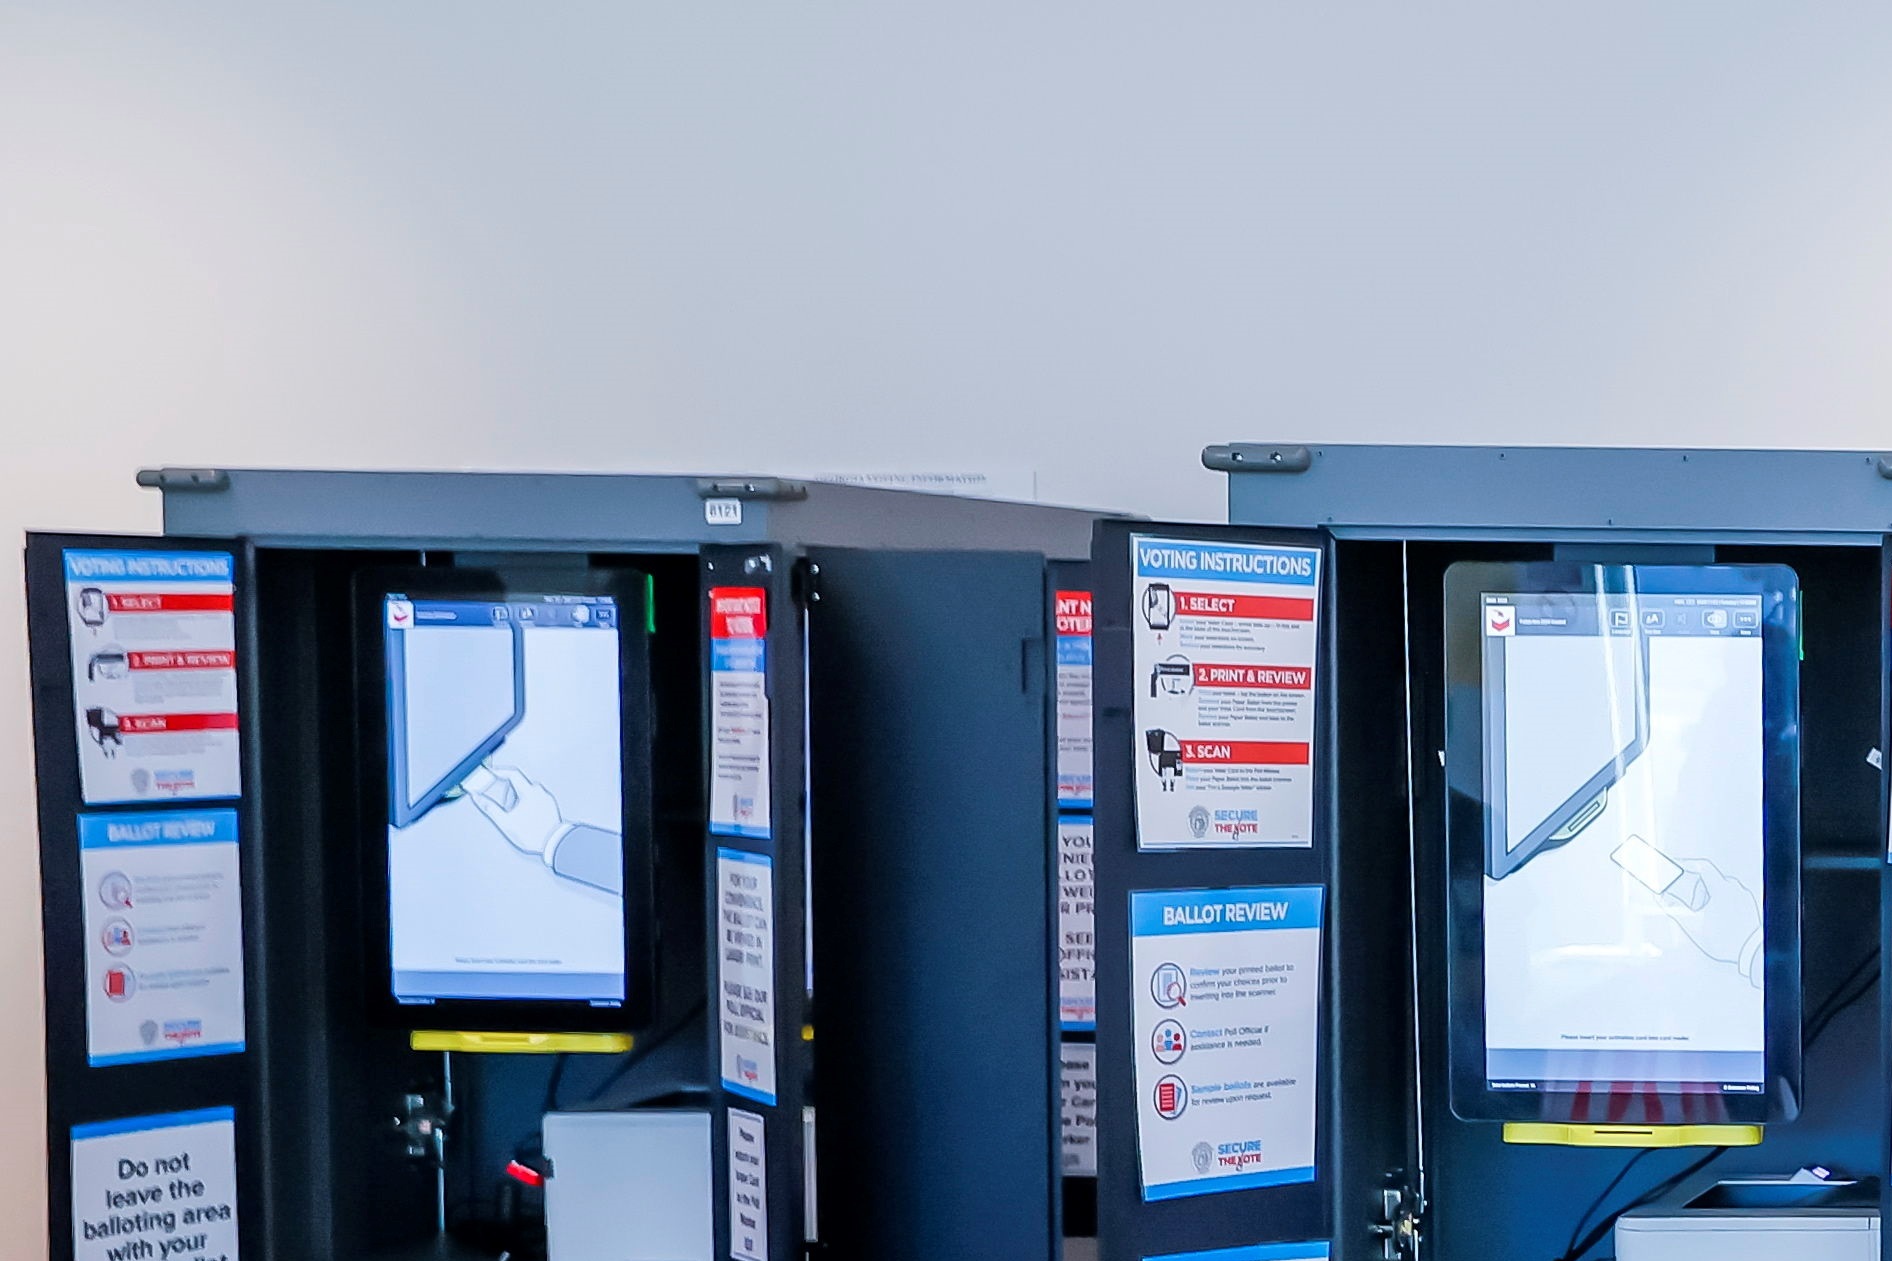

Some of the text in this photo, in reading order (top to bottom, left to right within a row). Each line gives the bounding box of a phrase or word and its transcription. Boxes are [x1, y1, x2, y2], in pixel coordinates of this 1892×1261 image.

[71, 556, 126, 576] VOTING
[1140, 547, 1312, 577] VOTING INSTRUCTIONS
[1180, 596, 1236, 613] 1. SELECT
[1198, 668, 1306, 685] 2. PRINT & REVIEW
[1185, 744, 1231, 759] 3. SCAN
[1214, 810, 1258, 820] SECURE
[107, 820, 216, 842] BALLOT REVIEW
[1163, 902, 1289, 925] BALLOT REVIEW
[1218, 1140, 1262, 1155] SECURE
[118, 1152, 190, 1180] Do not
[106, 1179, 205, 1210] leave the
[83, 1203, 232, 1241] balloting area
[159, 1233, 208, 1261] your
